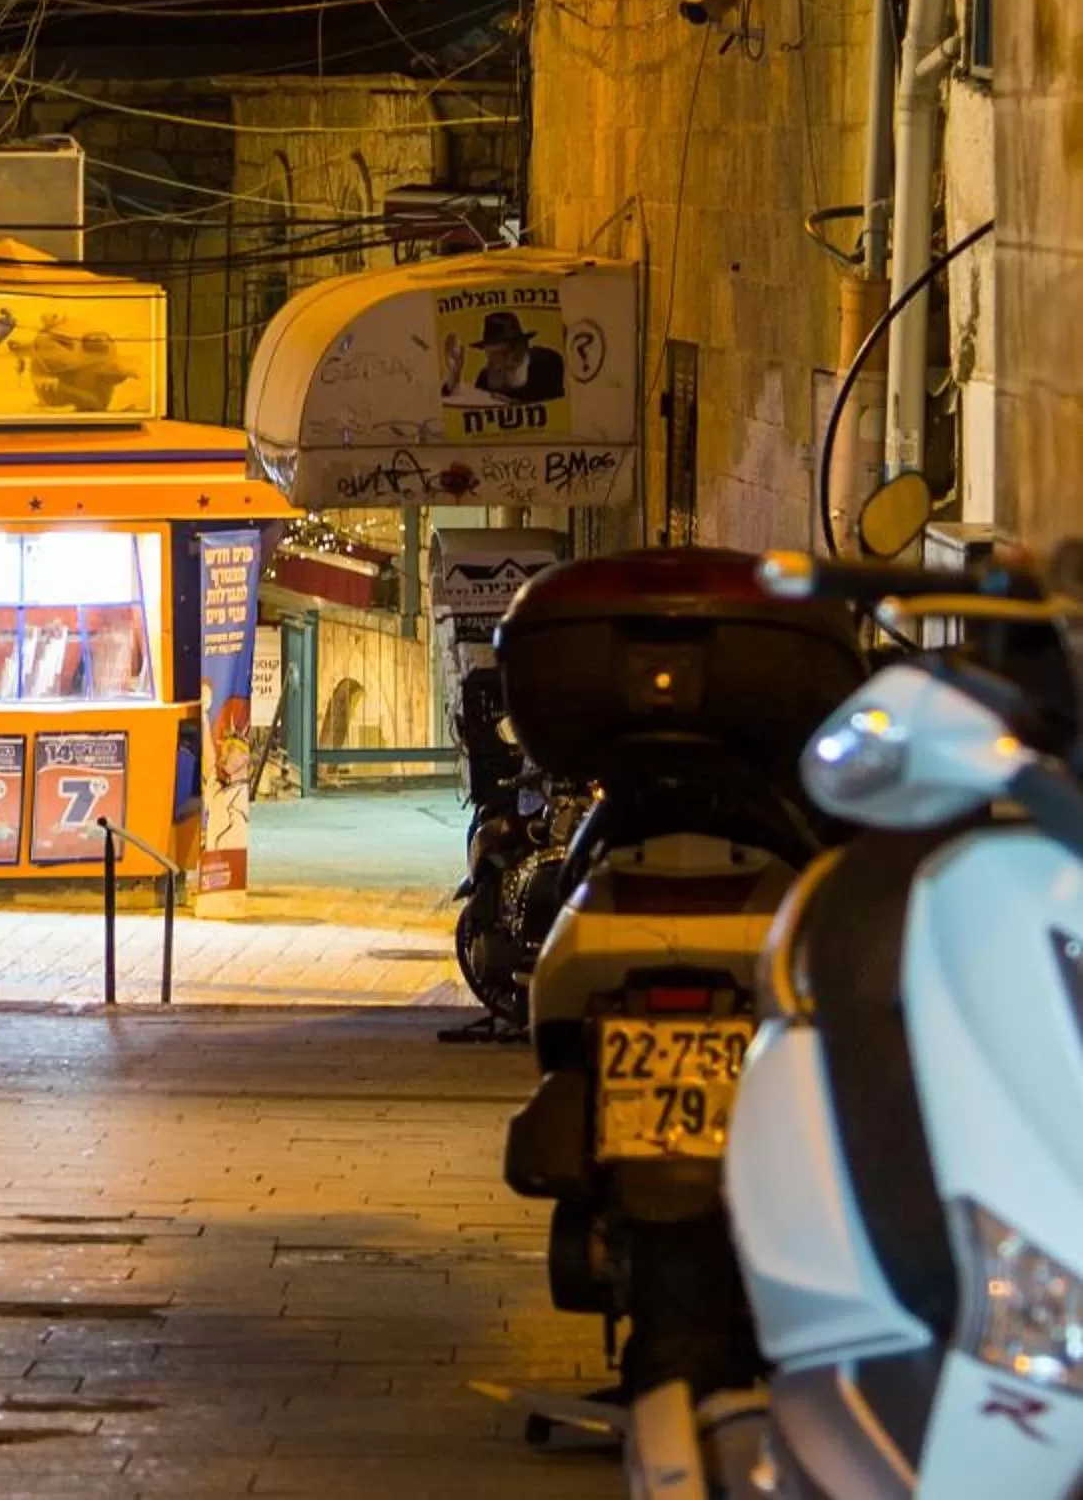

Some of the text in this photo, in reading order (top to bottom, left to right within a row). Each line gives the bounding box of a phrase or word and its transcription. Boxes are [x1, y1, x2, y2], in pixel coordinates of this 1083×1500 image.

[437, 287, 559, 315] ברכה והצלחה
[463, 404, 547, 434] משיח
[653, 1085, 706, 1135] 79
